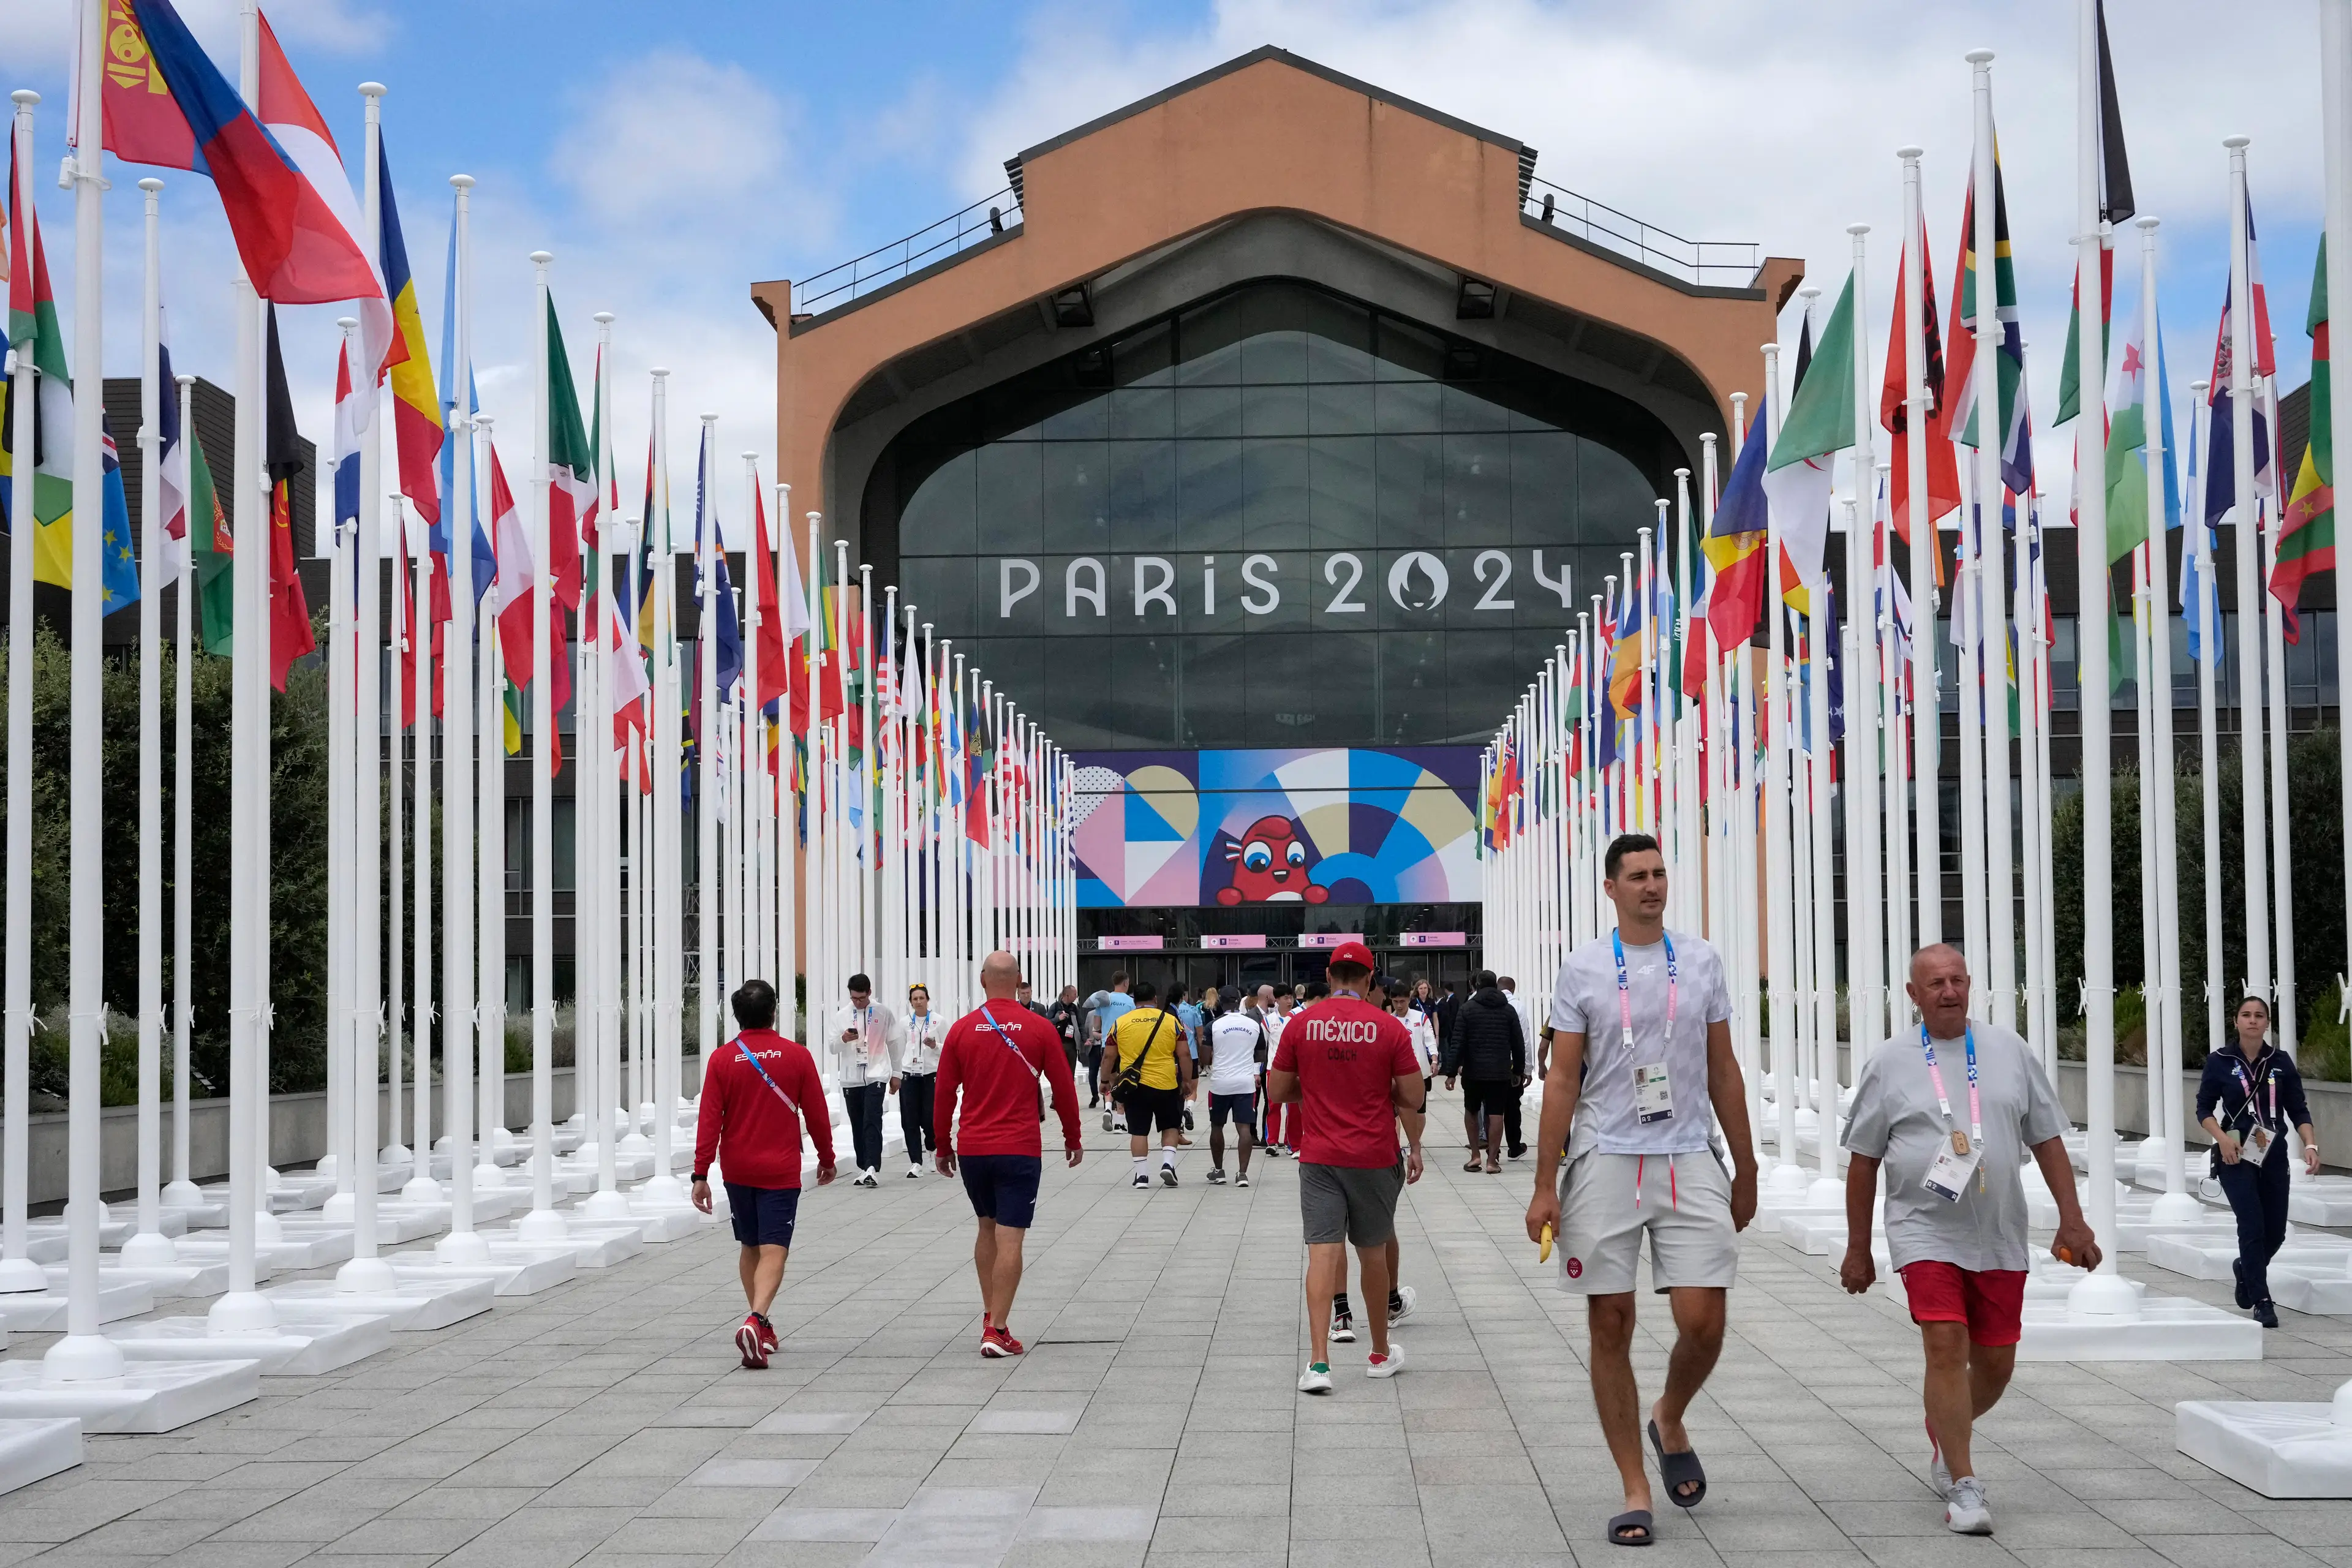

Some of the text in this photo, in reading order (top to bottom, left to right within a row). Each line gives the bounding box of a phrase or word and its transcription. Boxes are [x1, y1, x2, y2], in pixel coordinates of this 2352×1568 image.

[1324, 549, 1572, 611] 2024
[1637, 965, 1657, 974] 4F
[1223, 1027, 1253, 1036] DOMINICANA
[1306, 1016, 1377, 1043] MÉXICO
[1327, 1047, 1358, 1061] COACH
